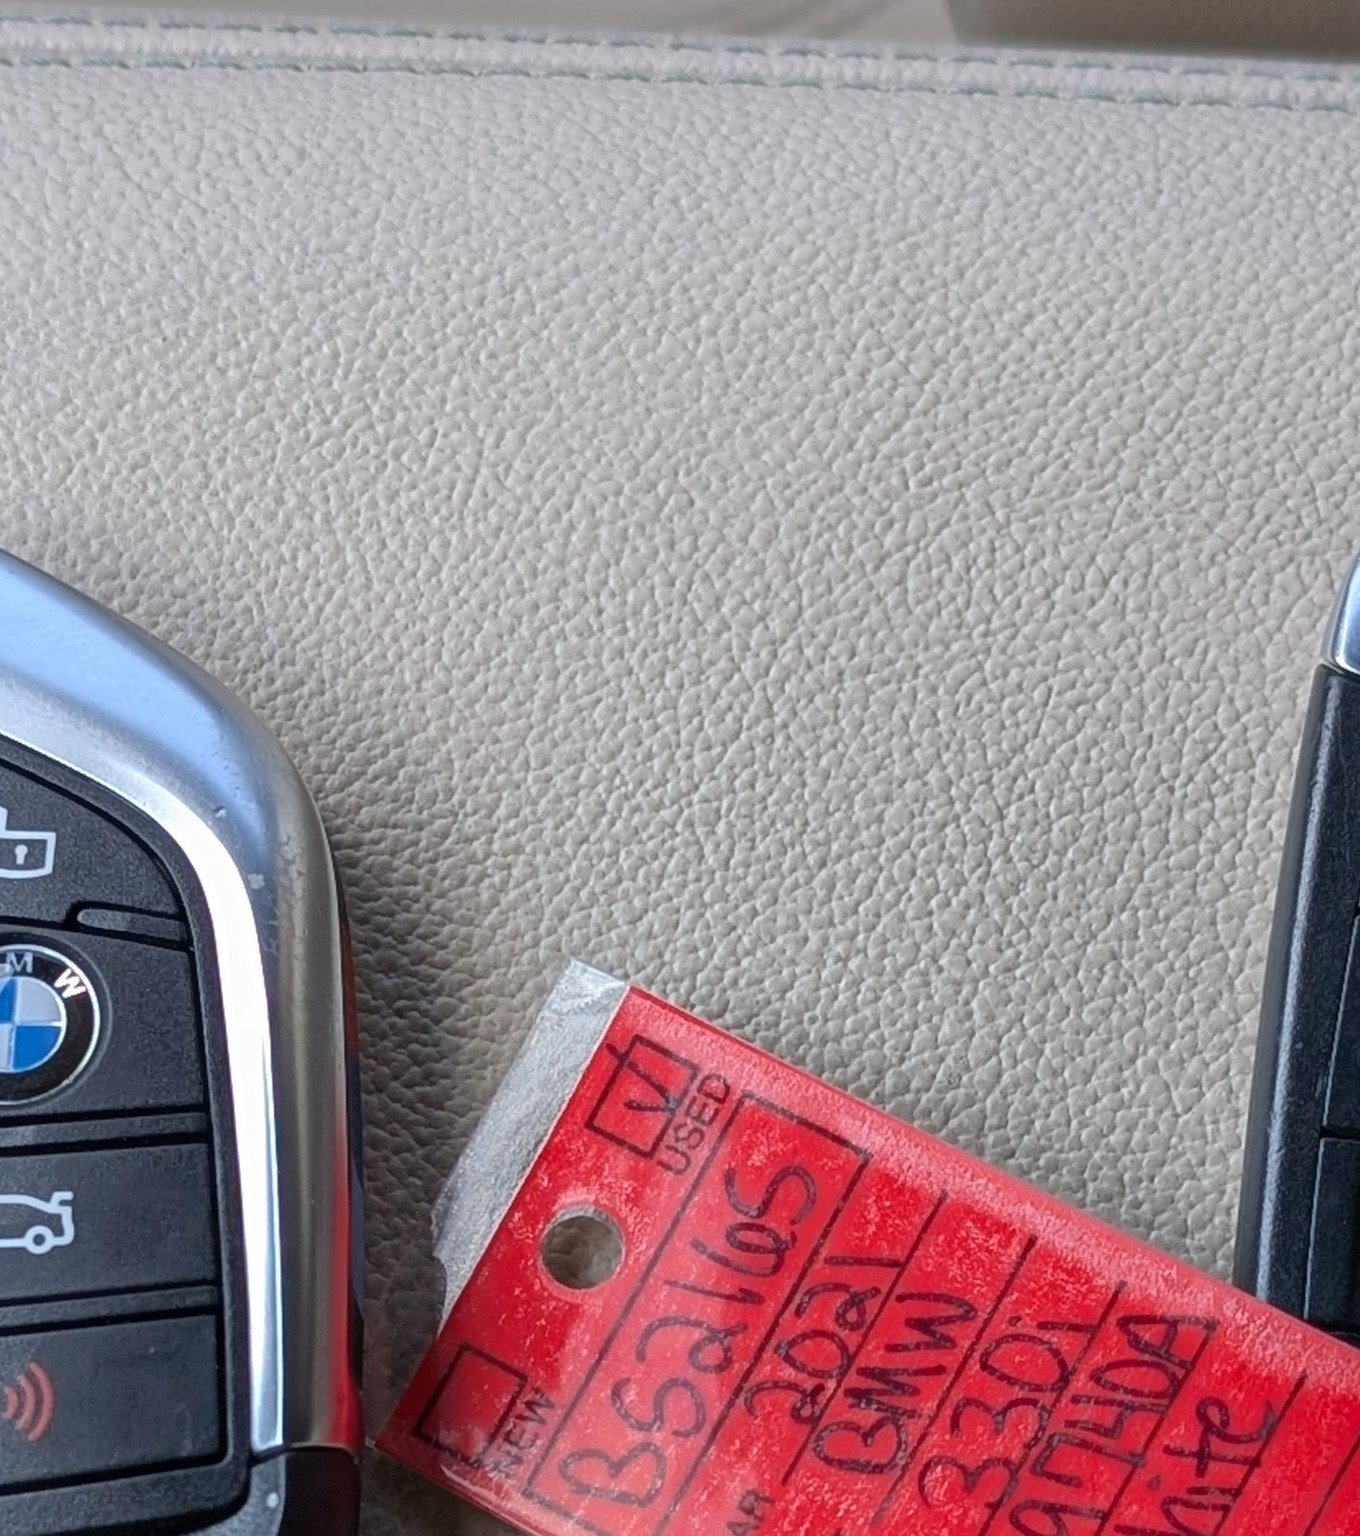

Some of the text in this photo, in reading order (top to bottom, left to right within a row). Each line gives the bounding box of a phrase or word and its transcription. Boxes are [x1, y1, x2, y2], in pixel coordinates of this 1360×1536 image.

[656, 1072, 731, 1177] USED
[742, 1254, 903, 1425] 2021
[812, 1292, 978, 1475] BMW
[917, 1315, 1096, 1512] 330i
[491, 1384, 557, 1480] NEW
